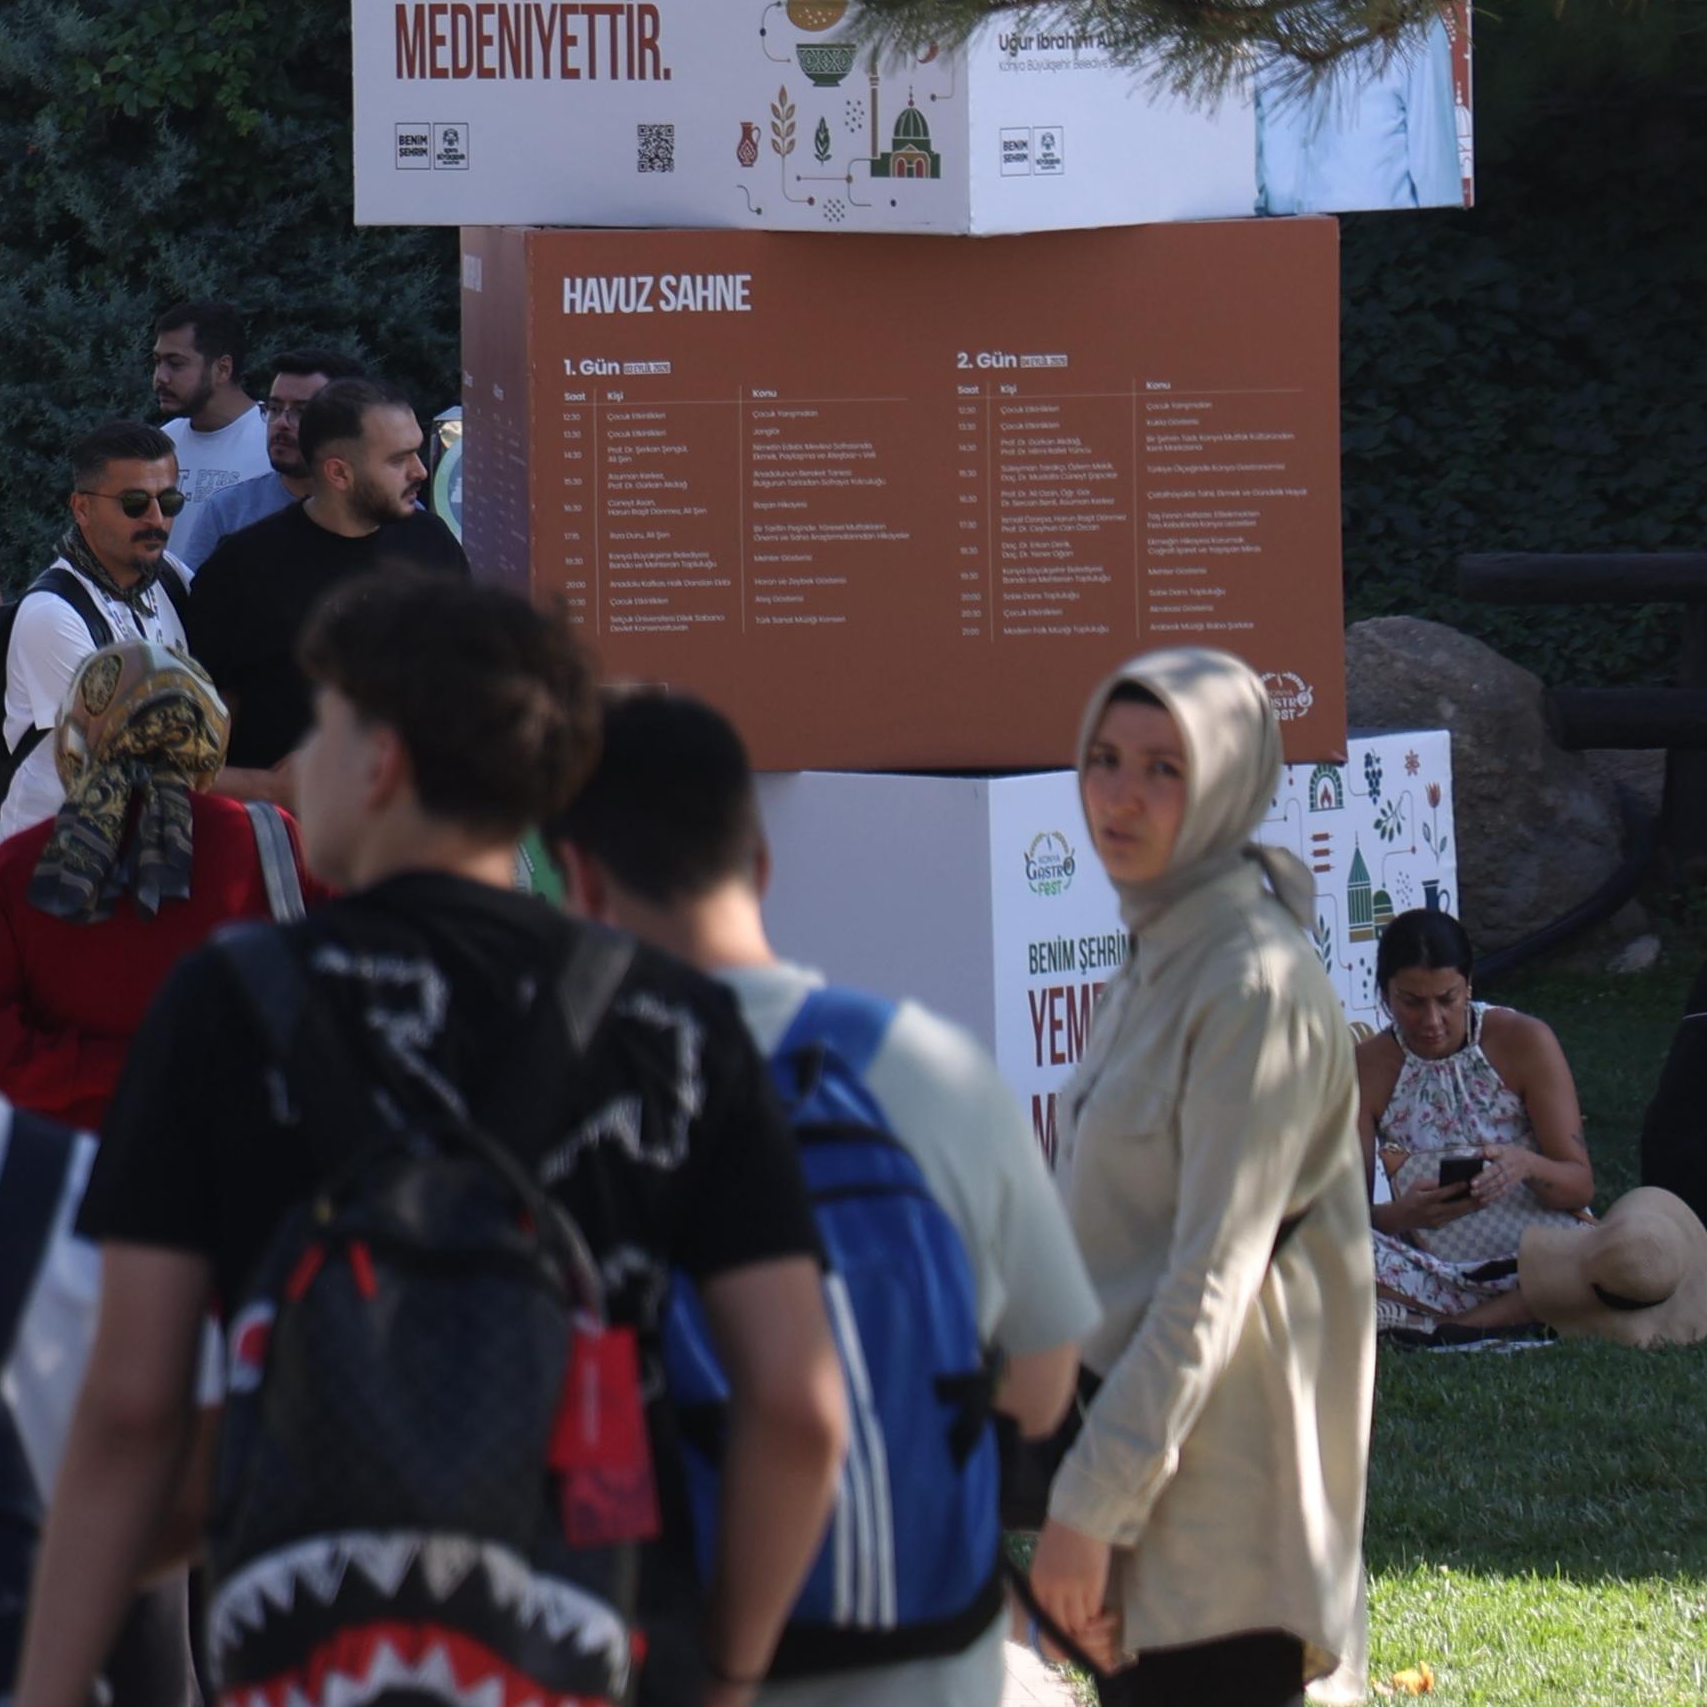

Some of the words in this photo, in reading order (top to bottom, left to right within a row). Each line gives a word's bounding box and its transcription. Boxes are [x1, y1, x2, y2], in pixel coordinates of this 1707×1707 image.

[998, 32, 1034, 57] Uğur
[399, 135, 428, 146] BENİM
[563, 276, 654, 314] HAVUZ
[659, 274, 752, 312] SAHNE
[563, 358, 576, 376] 1.
[579, 357, 620, 376] Gün
[956, 351, 973, 369] 2.
[976, 350, 1018, 368] Gün
[563, 391, 586, 402] Saat
[606, 390, 624, 403] Kişi
[752, 389, 778, 398] Konu
[957, 385, 979, 394] Saat
[1000, 383, 1017, 395] Kişi
[1146, 381, 1171, 390] Konu
[1028, 935, 1076, 975] BENİM
[1028, 982, 1106, 1067] YEM
